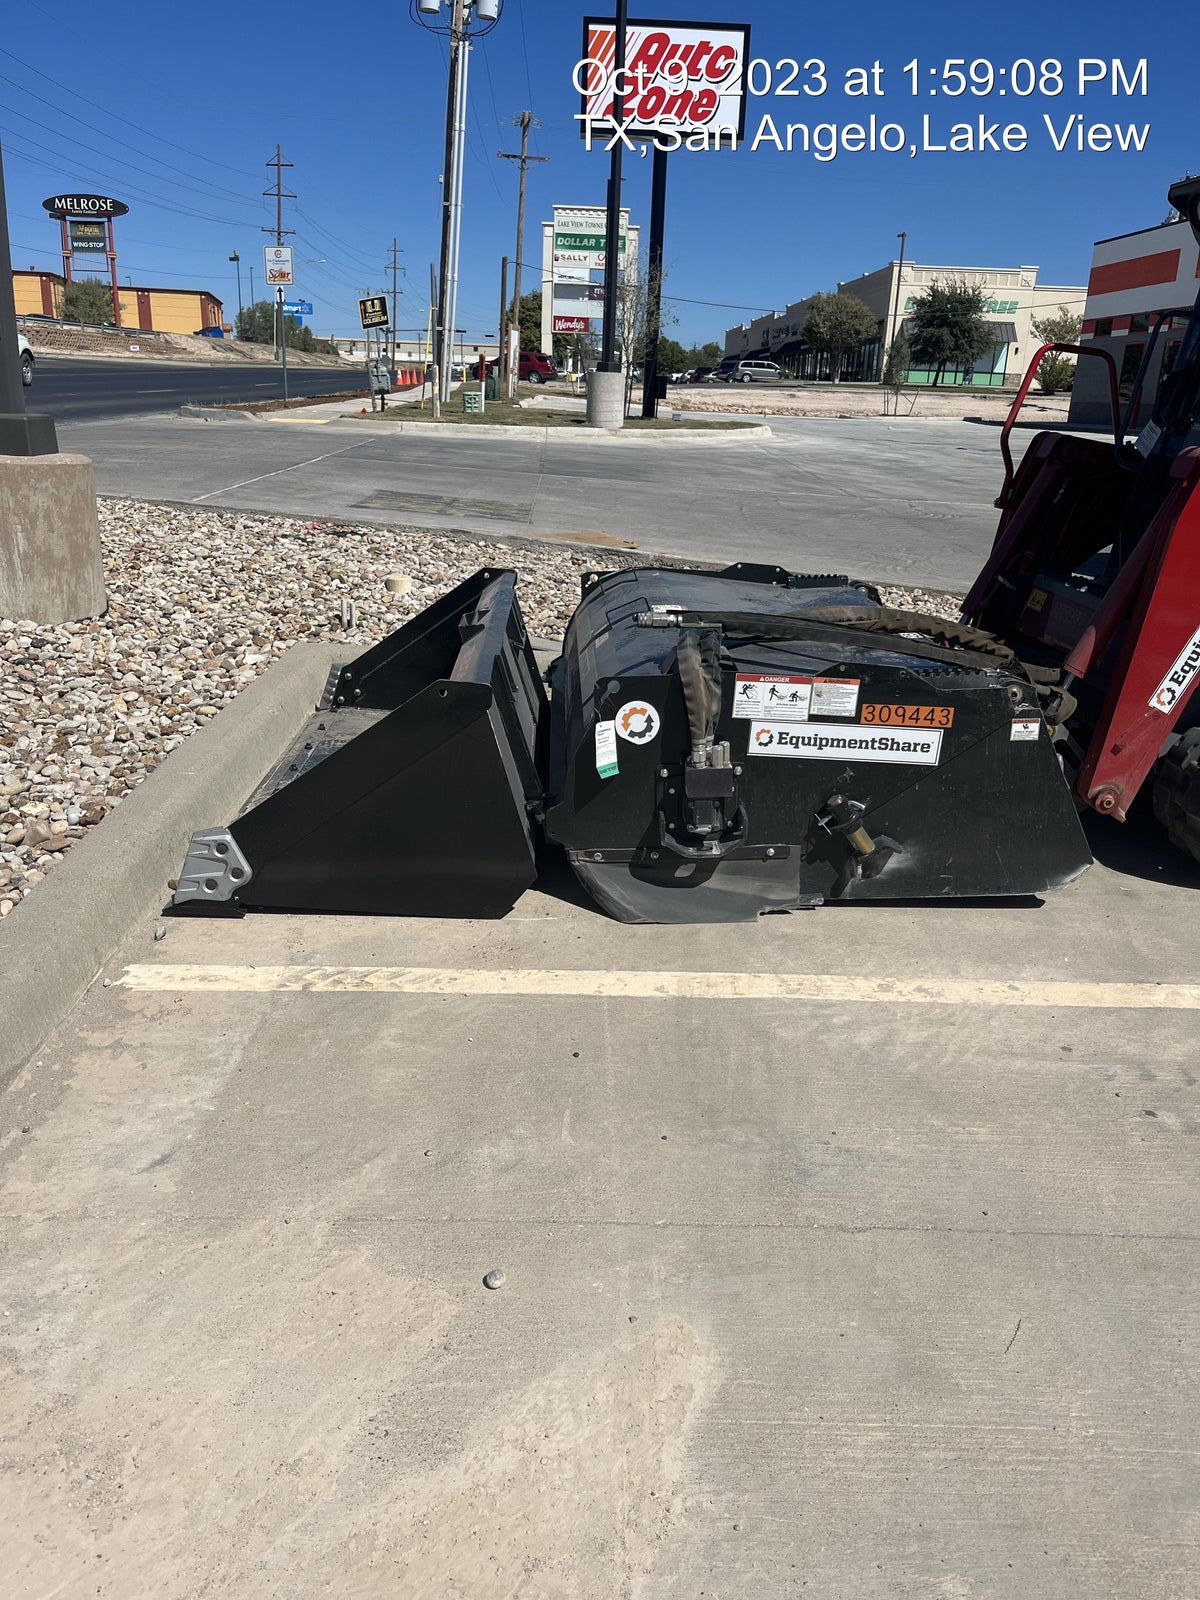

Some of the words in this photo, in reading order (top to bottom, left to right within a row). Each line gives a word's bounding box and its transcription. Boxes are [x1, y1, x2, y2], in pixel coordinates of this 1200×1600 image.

[628, 32, 736, 80] Auto
[602, 75, 719, 122] Zone
[54, 197, 114, 211] MELROSE
[585, 221, 604, 229] TOWNE
[557, 237, 596, 247] DOLLAR
[599, 239, 624, 248] TE
[362, 315, 388, 325] COLISEUM
[555, 318, 585, 331] Wendy's
[863, 704, 951, 727] 309443
[776, 731, 931, 754] EquipmentShare
